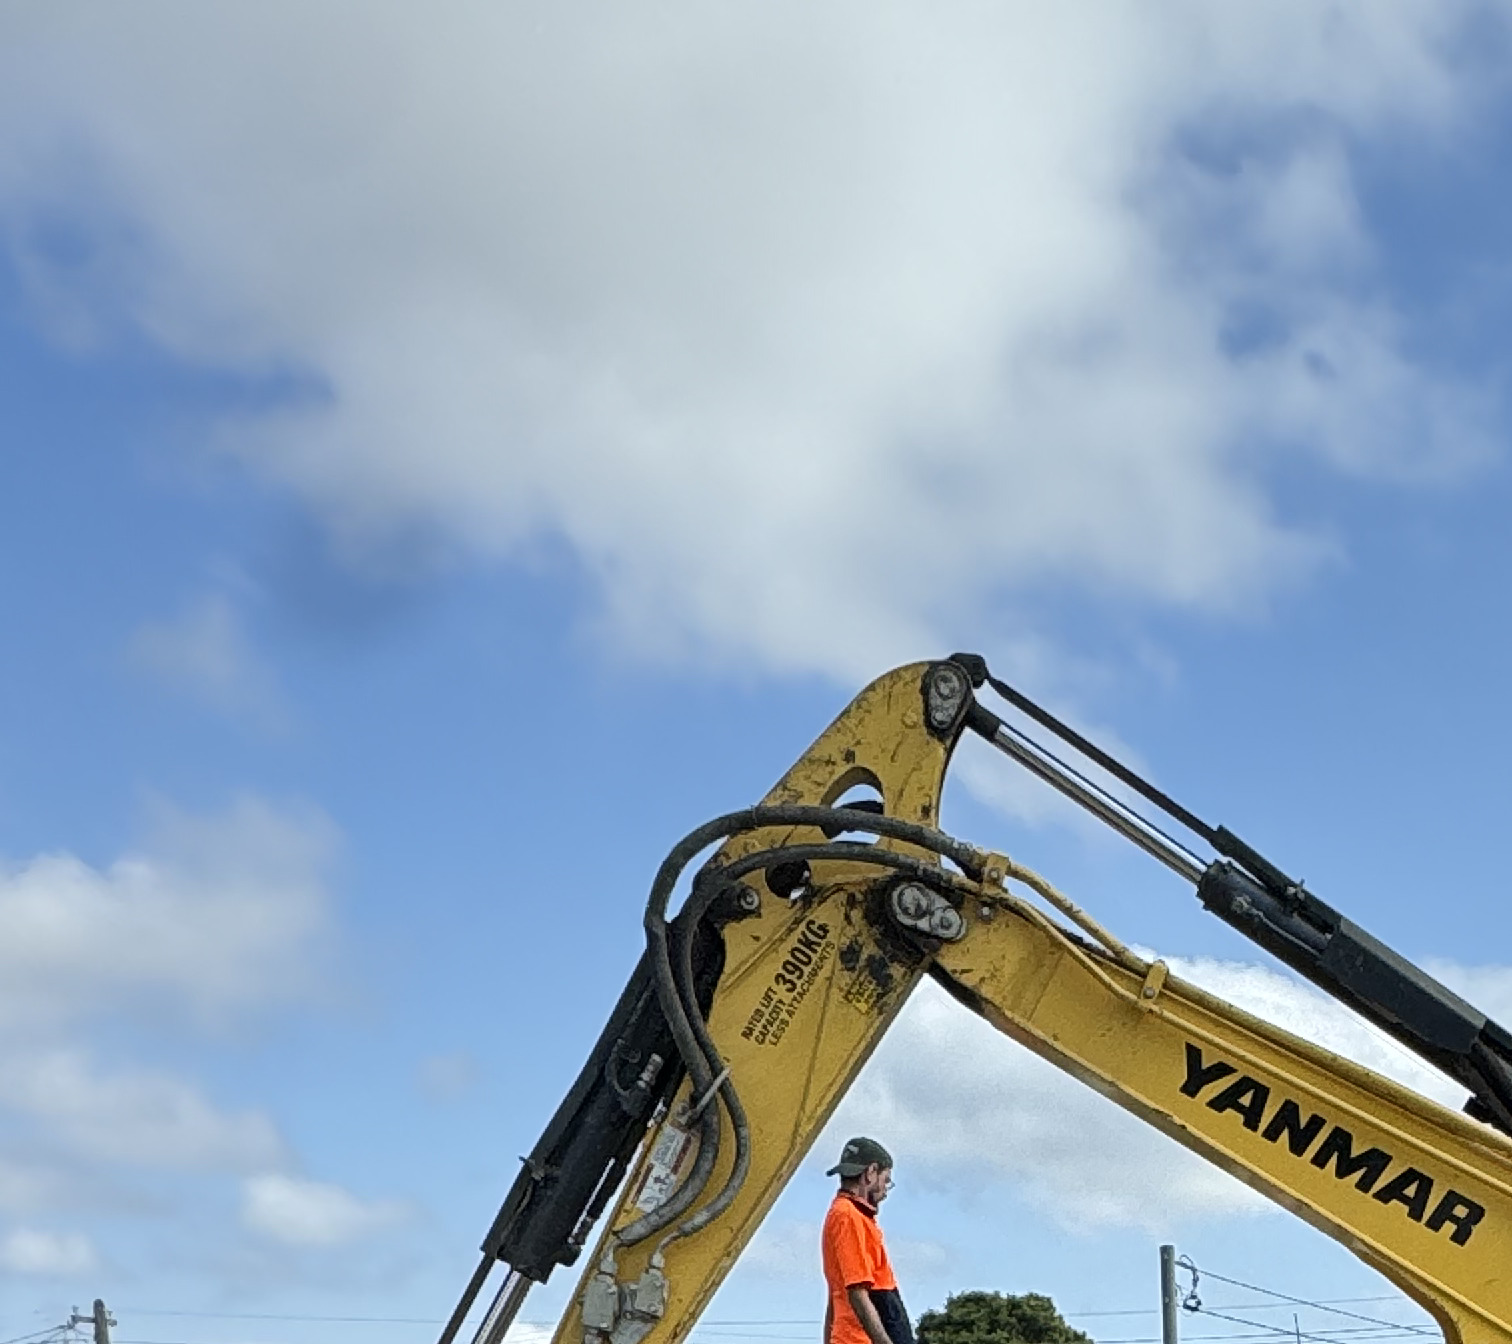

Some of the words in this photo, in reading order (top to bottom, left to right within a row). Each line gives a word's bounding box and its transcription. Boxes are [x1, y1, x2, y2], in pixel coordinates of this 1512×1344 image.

[774, 919, 829, 993] 390KG
[741, 1008, 765, 1041] RATED
[759, 986, 778, 1010] LIFT
[754, 998, 786, 1046] CAPACITY
[768, 1017, 790, 1047] LESS
[785, 941, 835, 1019] ATTACHMENTS
[1178, 1042, 1486, 1248] YANMAR
